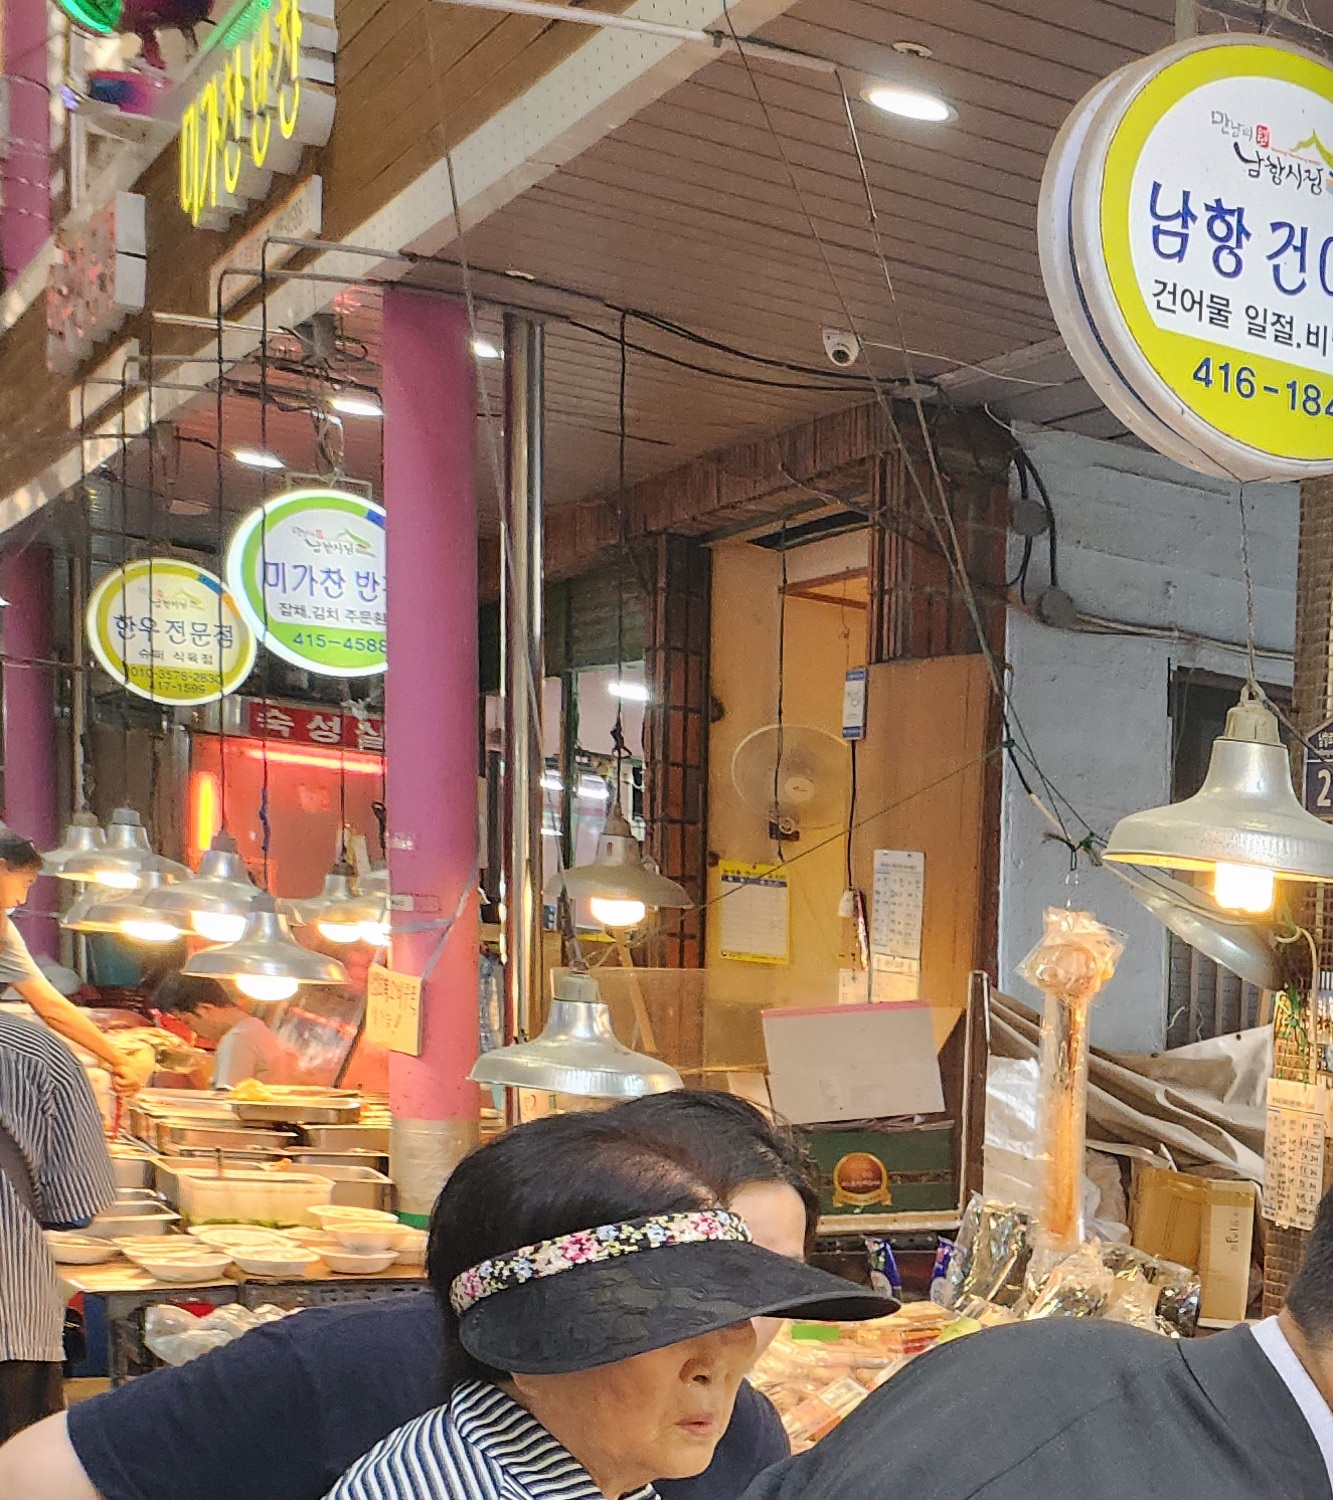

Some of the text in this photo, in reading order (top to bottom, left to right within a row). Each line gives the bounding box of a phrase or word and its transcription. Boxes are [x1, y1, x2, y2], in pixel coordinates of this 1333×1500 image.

[1233, 141, 1324, 196] 남항시장
[1149, 180, 1252, 280] 남항
[1151, 278, 1232, 329] 건어물
[264, 561, 386, 603] 미가찬 반
[113, 614, 234, 650] 한우 전문점
